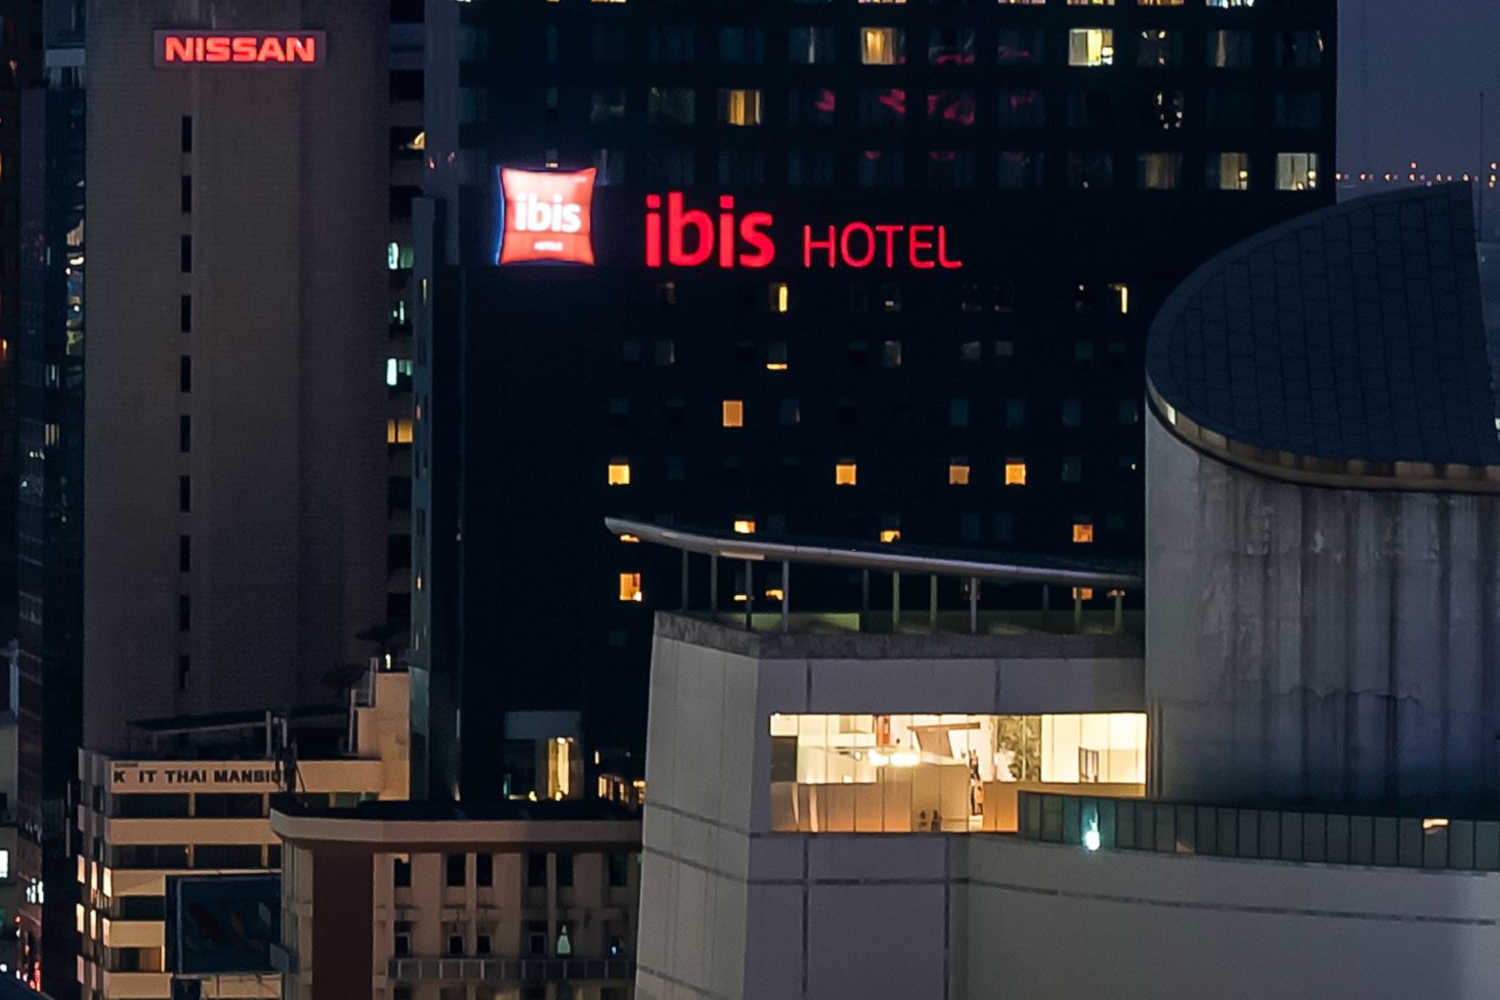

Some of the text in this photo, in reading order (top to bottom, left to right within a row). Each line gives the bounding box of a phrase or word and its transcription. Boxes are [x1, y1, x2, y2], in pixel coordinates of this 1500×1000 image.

[164, 36, 316, 63] NISSAN
[514, 191, 583, 234] ibis
[645, 191, 963, 269] ibis HOTEL
[164, 769, 208, 784] THAI
[213, 769, 289, 785] MANSIO
